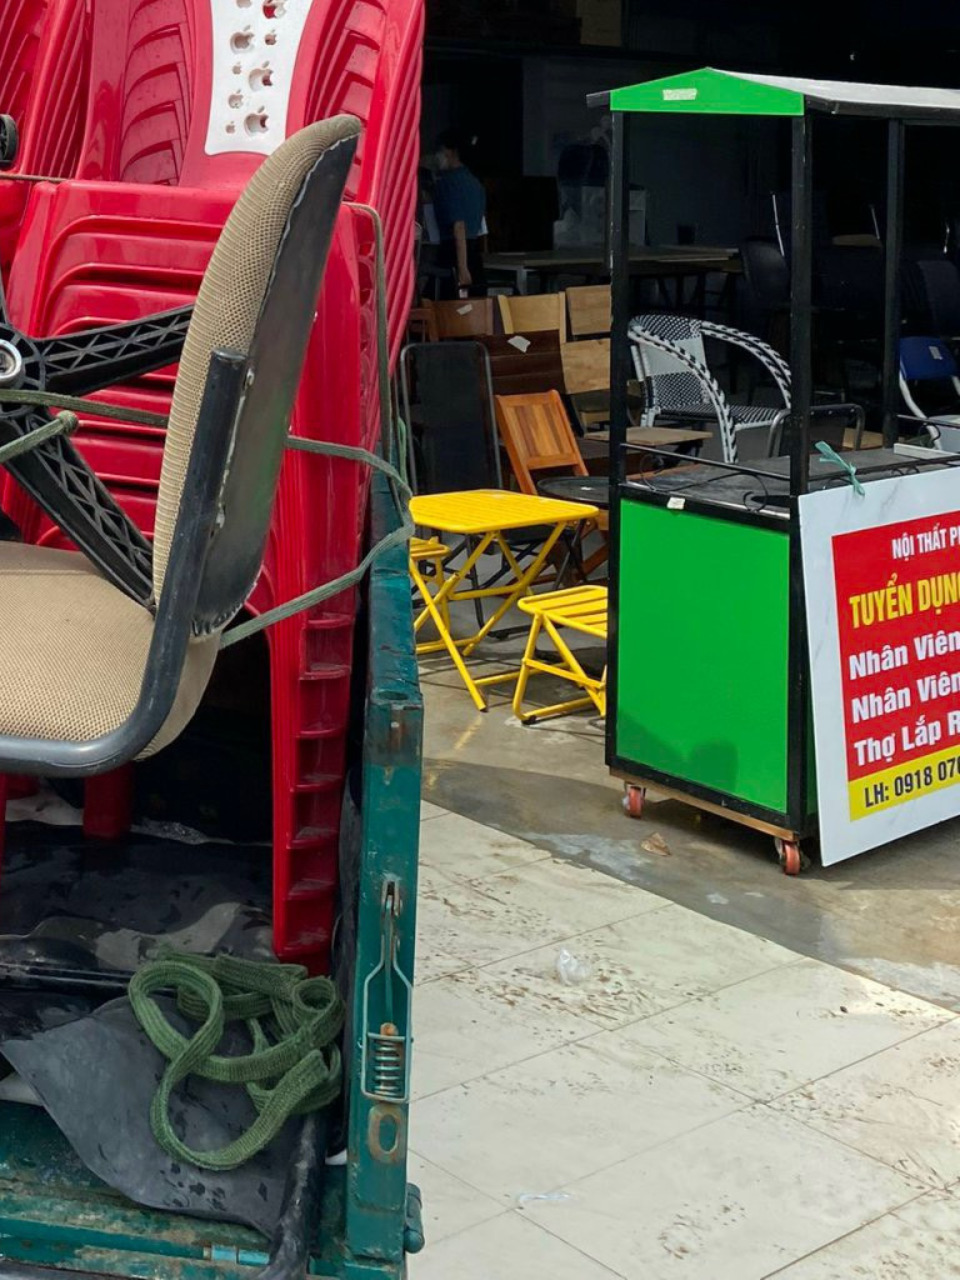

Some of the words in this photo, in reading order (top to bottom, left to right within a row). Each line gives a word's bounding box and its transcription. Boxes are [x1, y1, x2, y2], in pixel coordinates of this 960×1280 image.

[892, 532, 915, 561] NỘI
[917, 523, 947, 554] THẤT
[849, 572, 914, 629] TUYỂN
[849, 645, 908, 680] Nhân
[914, 630, 960, 661] Viên
[852, 687, 910, 724] Nhân
[917, 671, 960, 703] Viên
[854, 733, 895, 767] Thợ
[902, 714, 941, 751] Lắp
[865, 782, 889, 808] LH:
[894, 765, 933, 797] 0918
